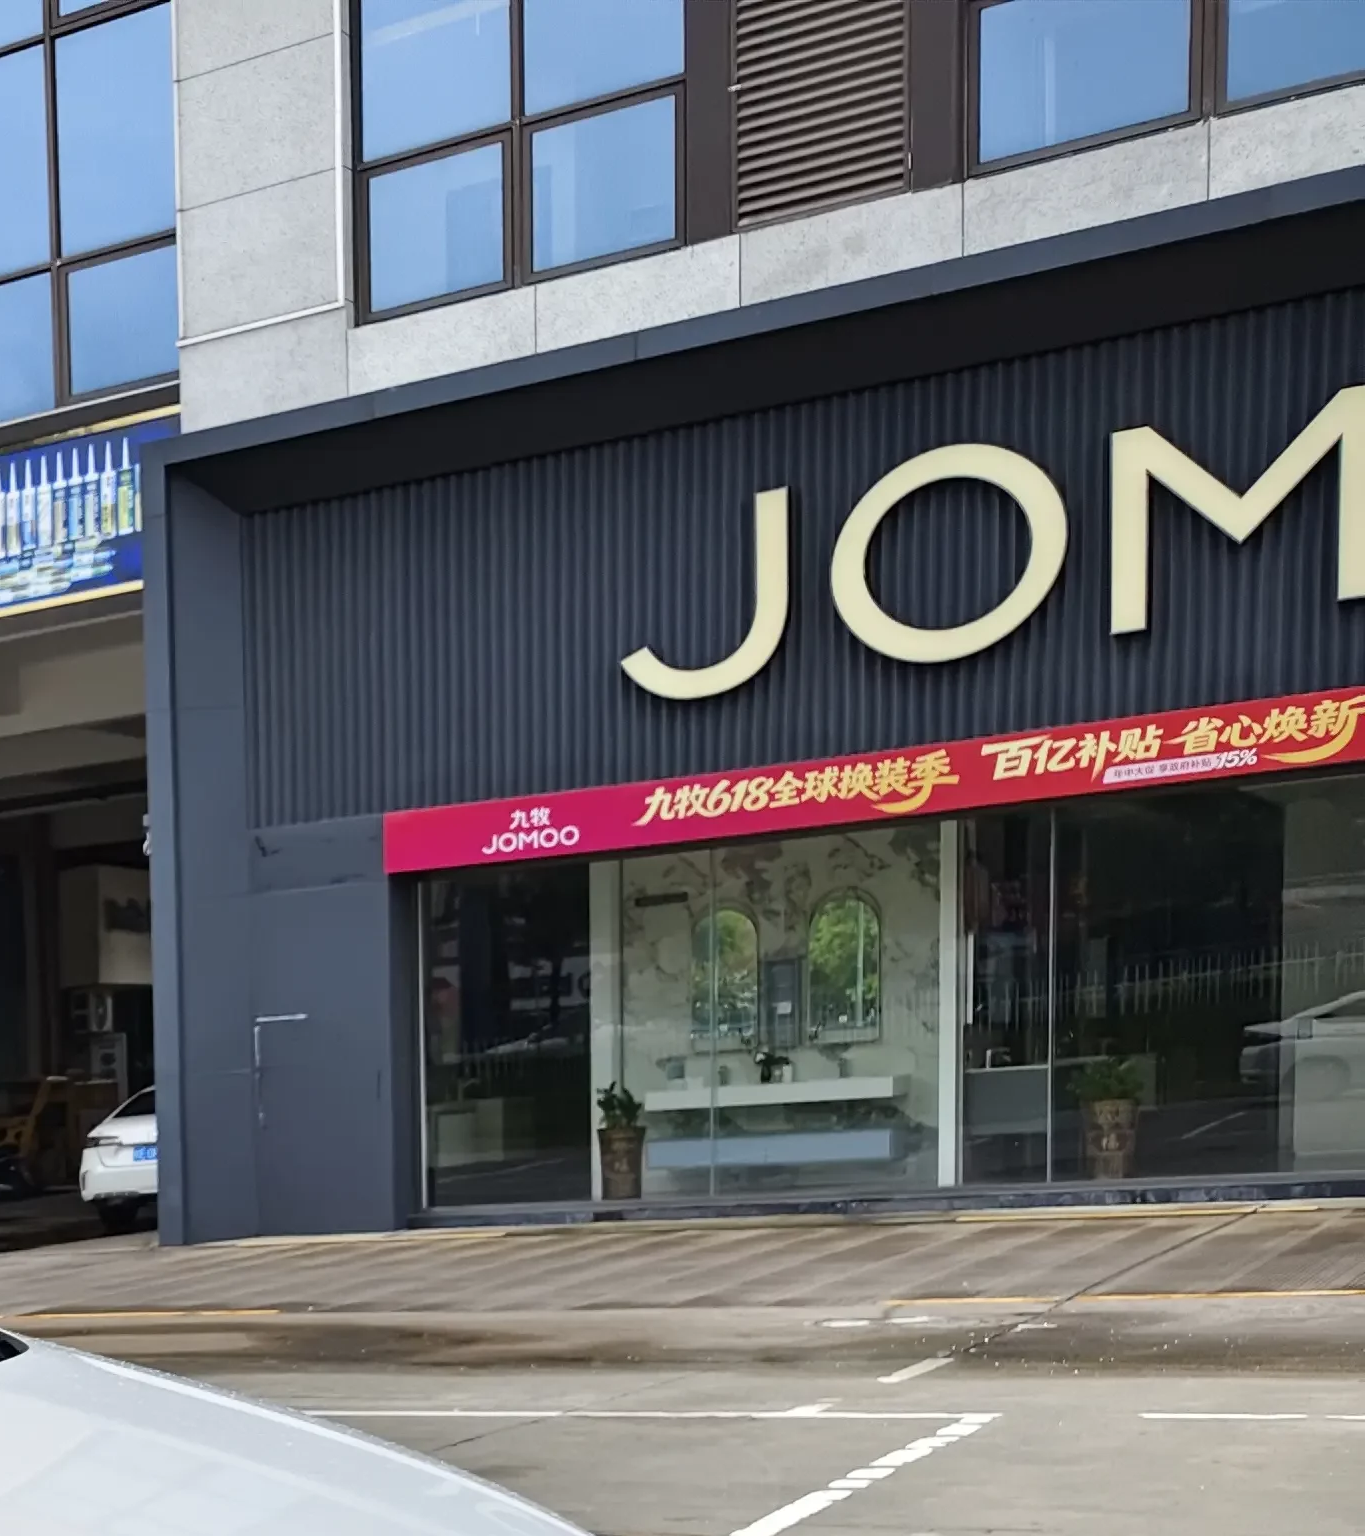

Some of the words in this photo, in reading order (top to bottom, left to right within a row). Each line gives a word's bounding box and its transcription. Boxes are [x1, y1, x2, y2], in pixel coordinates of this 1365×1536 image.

[631, 749, 960, 826] 九牧618全球换装季
[981, 724, 1163, 783] 百亿补贴
[1169, 694, 1365, 764] 省心焕新
[509, 806, 551, 830] 九牧
[481, 825, 580, 855] JOMOO
